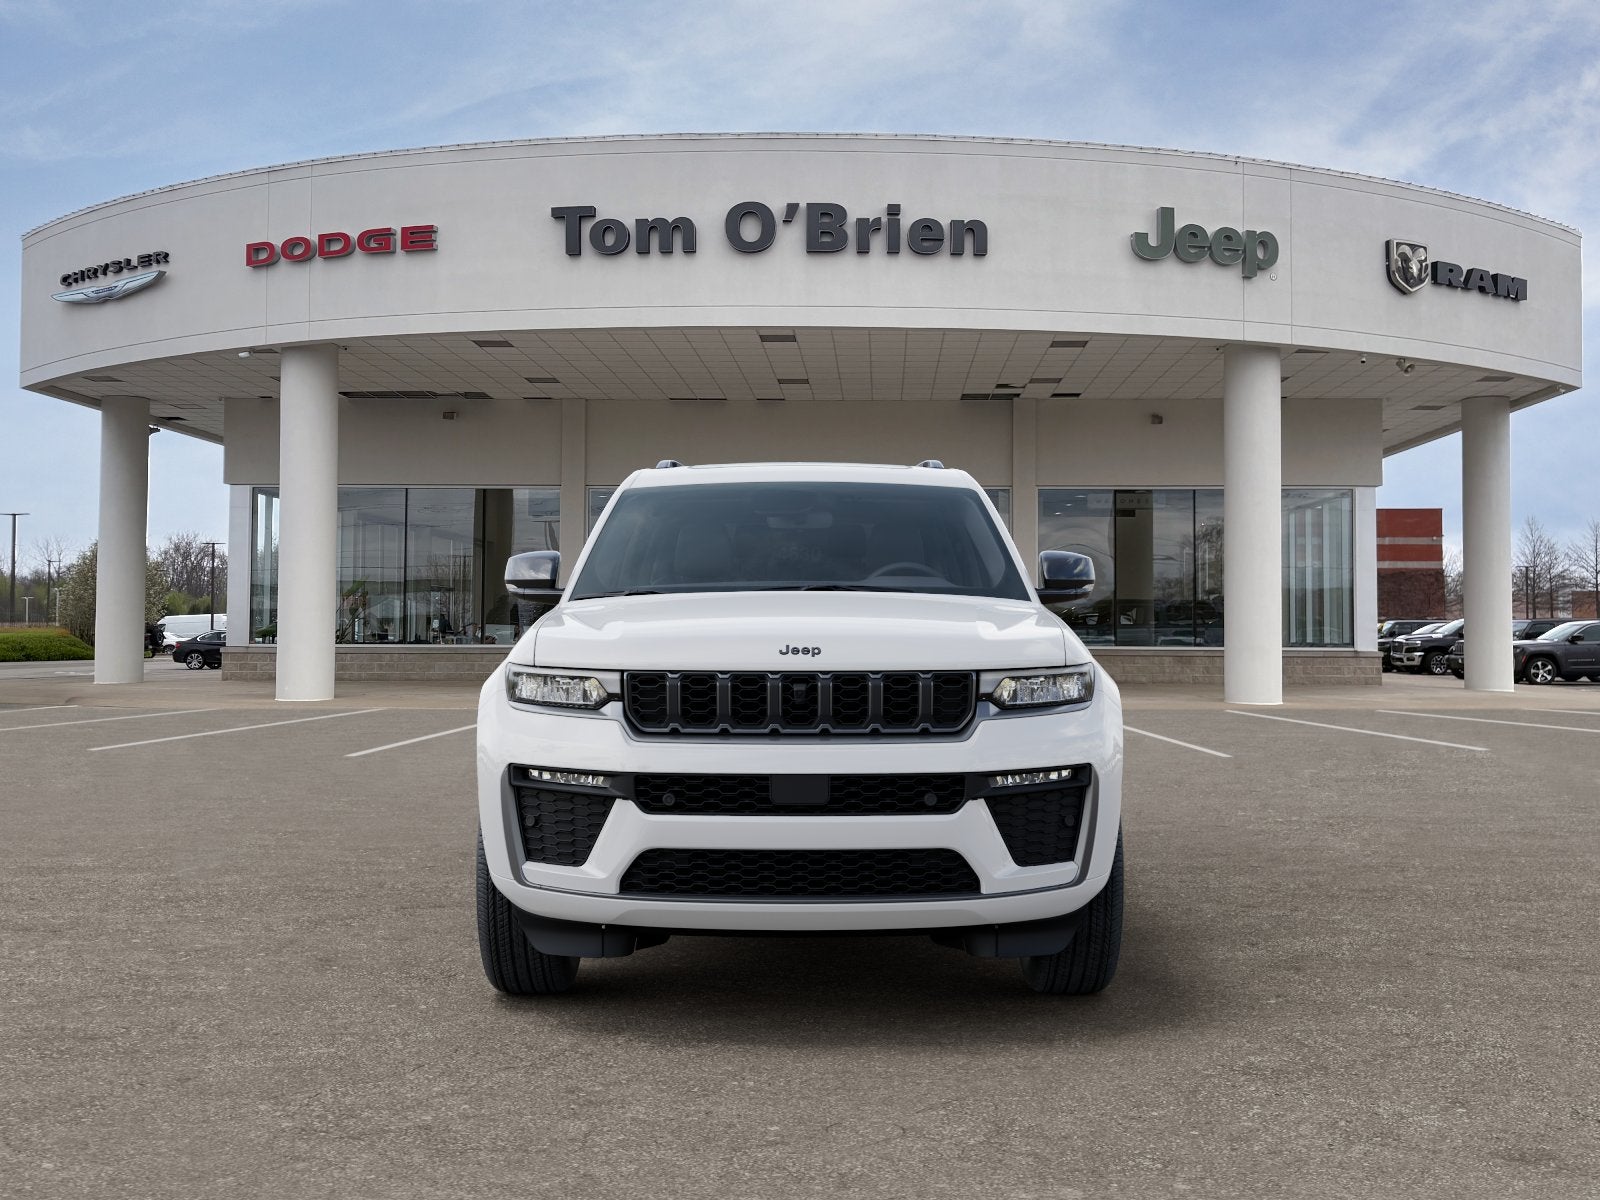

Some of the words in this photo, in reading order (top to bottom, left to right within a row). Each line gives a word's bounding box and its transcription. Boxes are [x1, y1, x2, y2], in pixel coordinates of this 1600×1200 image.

[245, 225, 438, 269] DODGE
[551, 205, 697, 256] Tom
[725, 201, 988, 256] O'Brien
[1131, 207, 1279, 278] Jeep
[60, 251, 170, 287] CHRYSLER
[1431, 261, 1528, 301] RAM
[778, 644, 822, 657] Jeep
